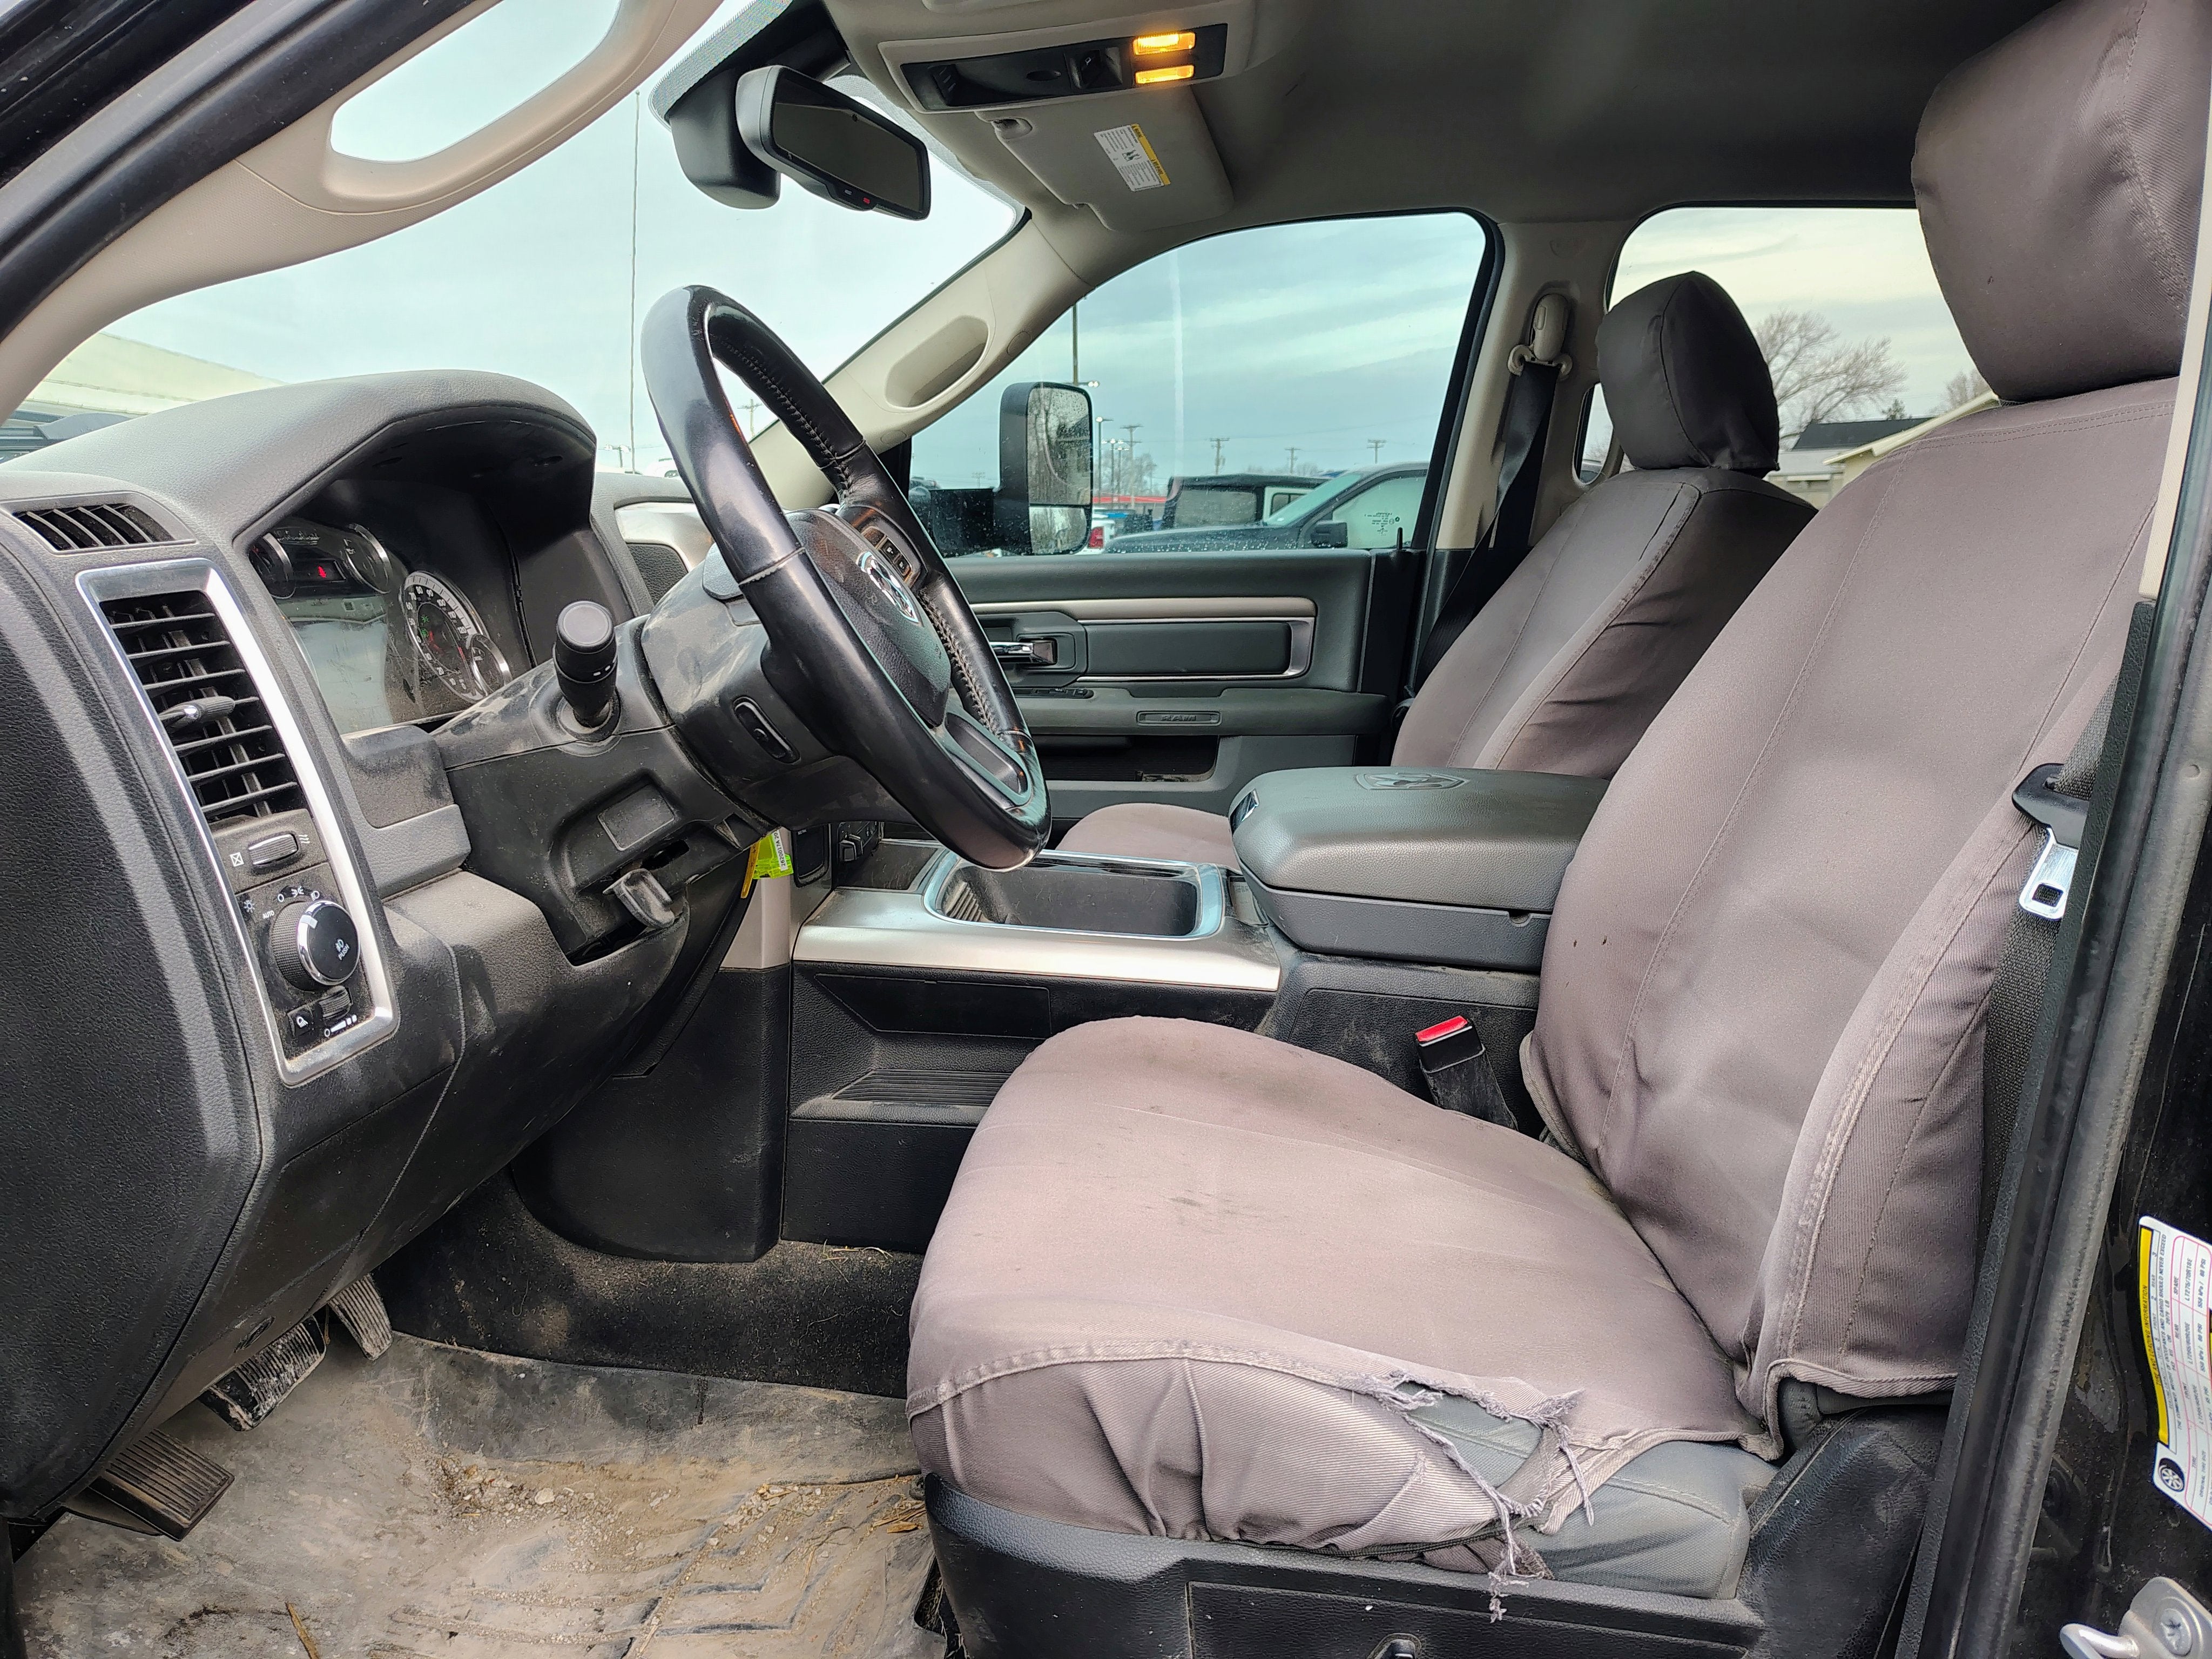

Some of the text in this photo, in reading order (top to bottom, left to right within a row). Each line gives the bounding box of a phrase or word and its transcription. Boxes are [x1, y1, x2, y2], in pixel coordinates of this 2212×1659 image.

[437, 667, 444, 675] 20
[262, 910, 274, 919] AUTO
[338, 943, 350, 960] PUSH
